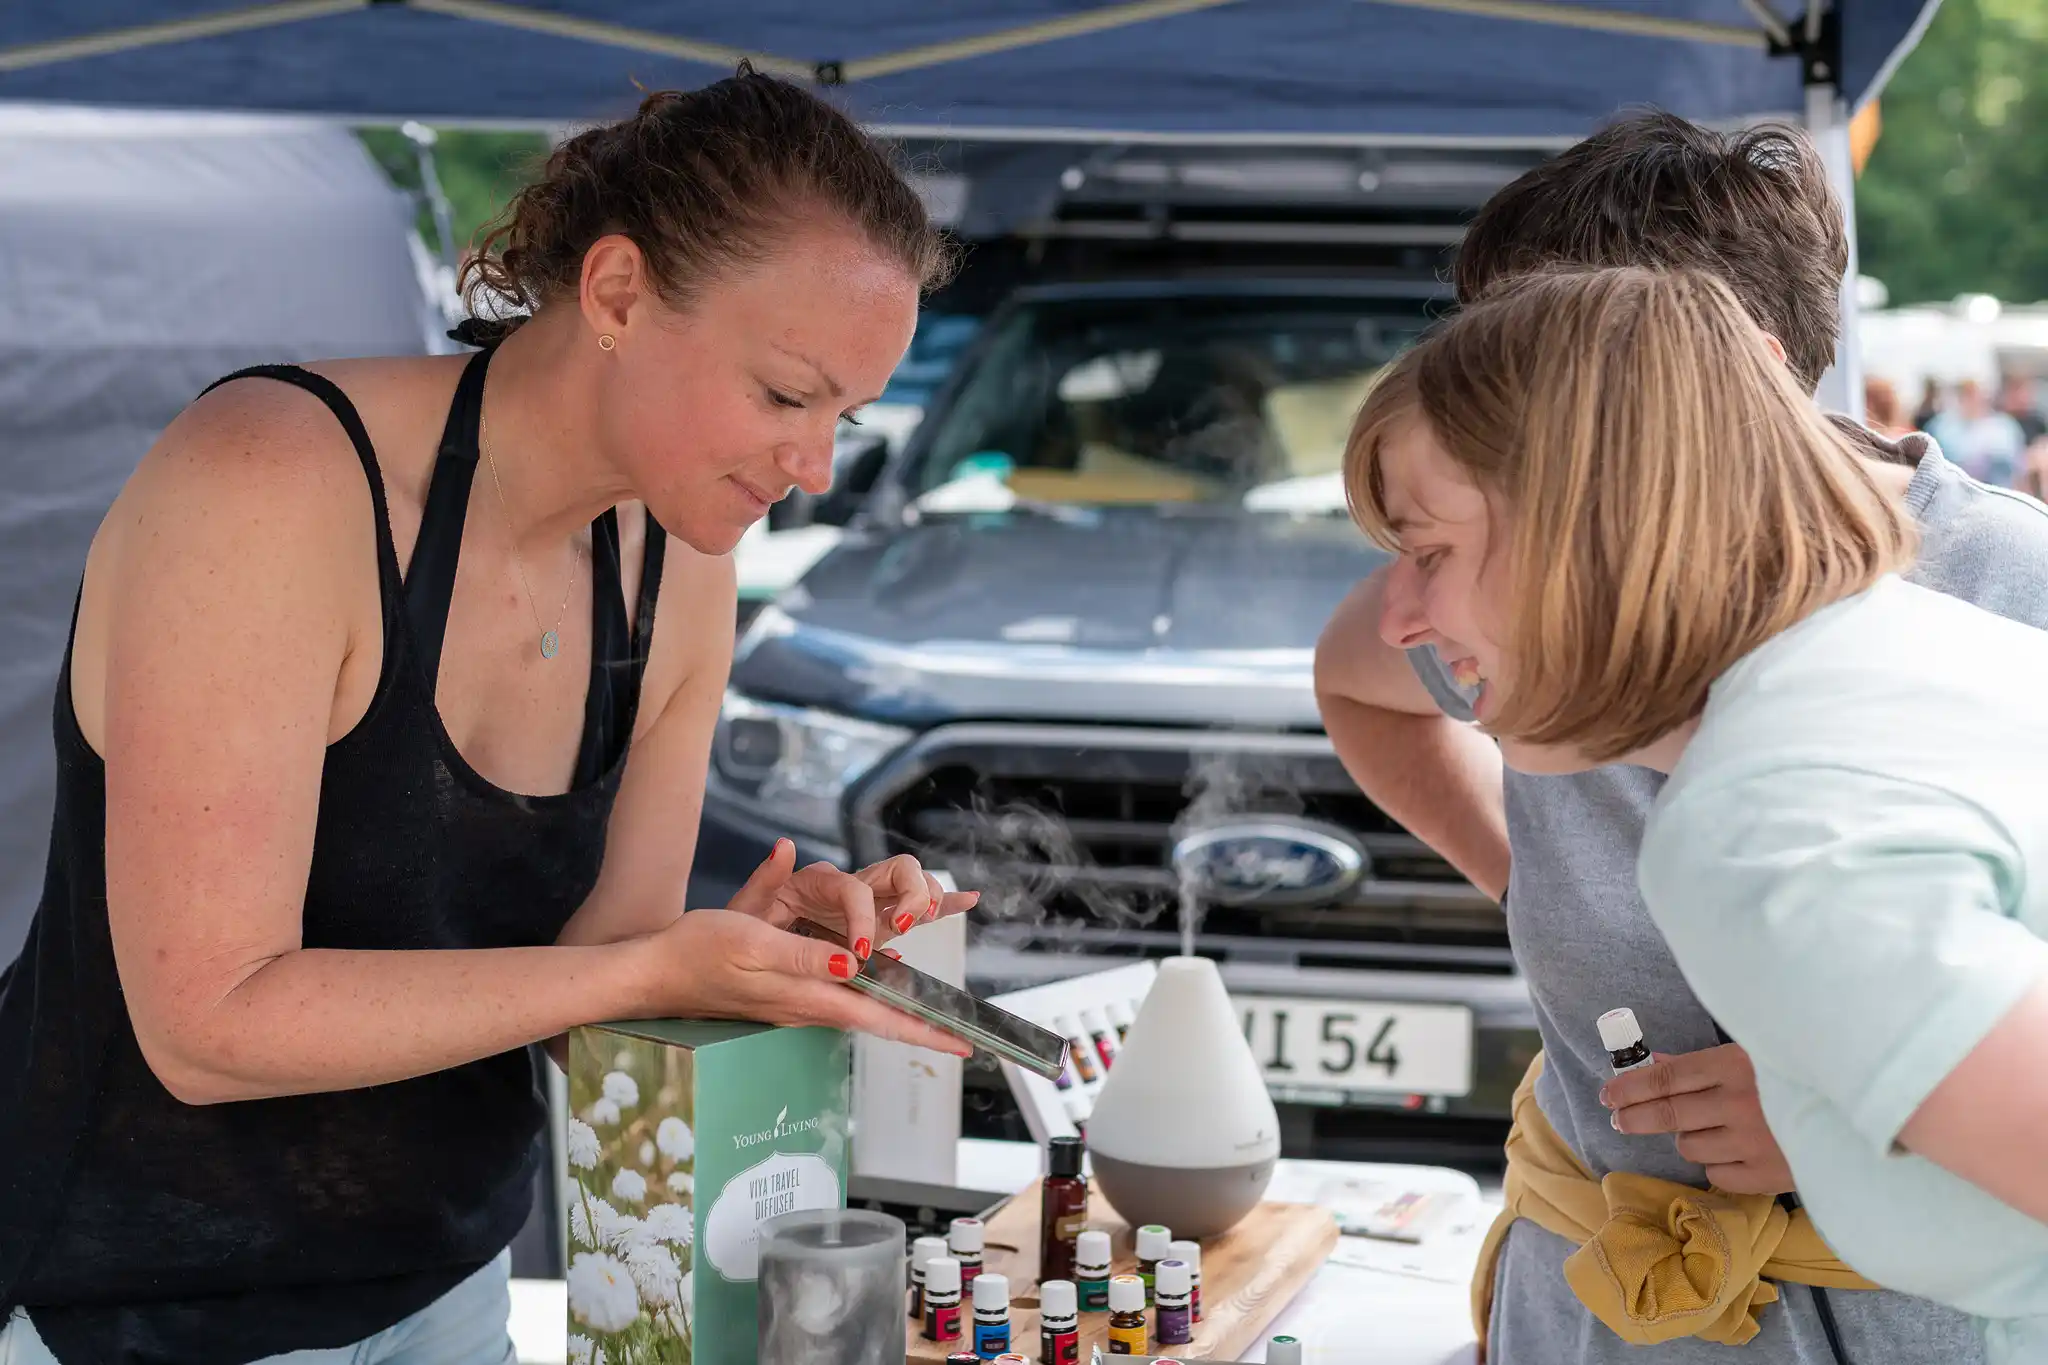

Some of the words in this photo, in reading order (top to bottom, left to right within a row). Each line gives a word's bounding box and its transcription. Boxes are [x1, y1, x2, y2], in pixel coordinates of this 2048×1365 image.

[1319, 1013, 1401, 1077] 54
[733, 1130, 772, 1150] YOUNG
[781, 1117, 819, 1137] LIVING
[771, 1167, 800, 1194] TRAVEL
[755, 1191, 794, 1221] DIFFUSER
